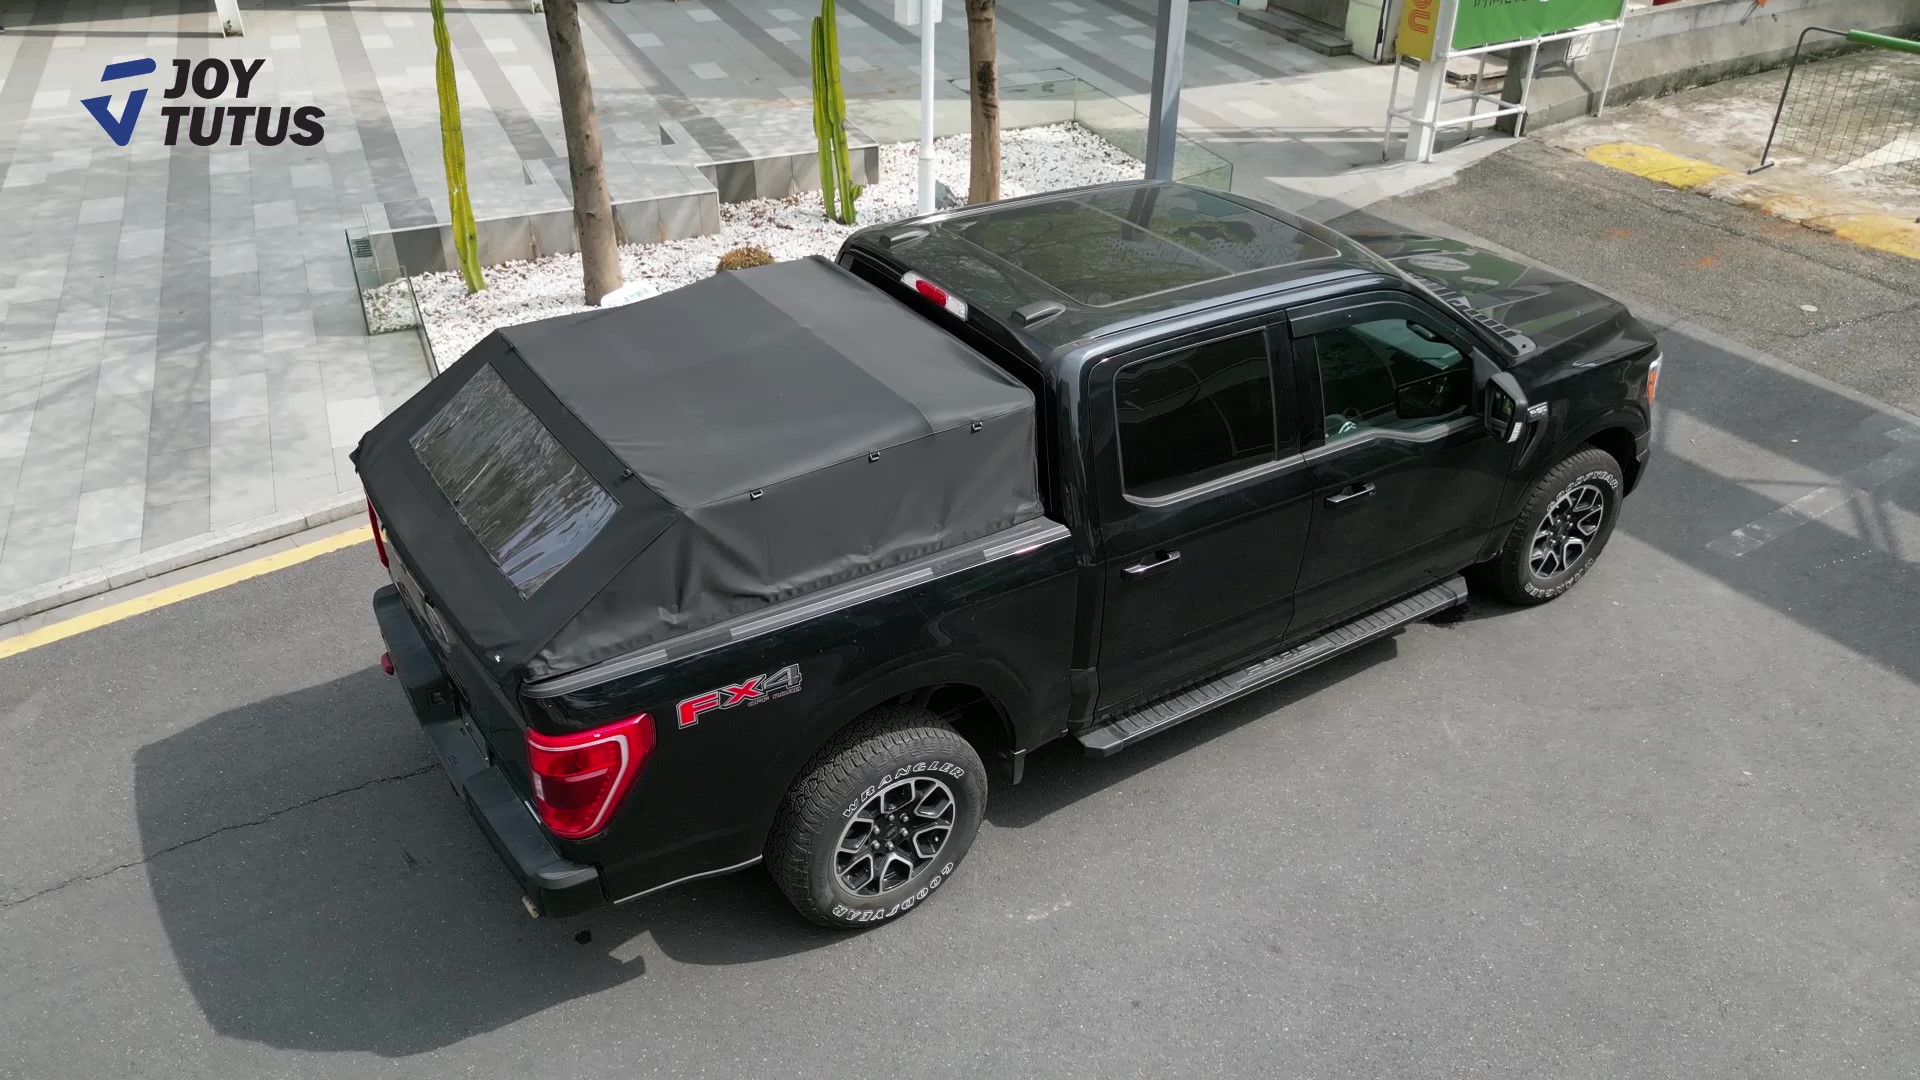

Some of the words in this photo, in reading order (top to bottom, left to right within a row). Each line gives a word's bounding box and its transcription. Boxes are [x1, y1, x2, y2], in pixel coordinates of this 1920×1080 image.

[676, 663, 802, 730] FX4
[843, 761, 965, 818] WRANGLER
[832, 862, 954, 922] GOODYEAR
